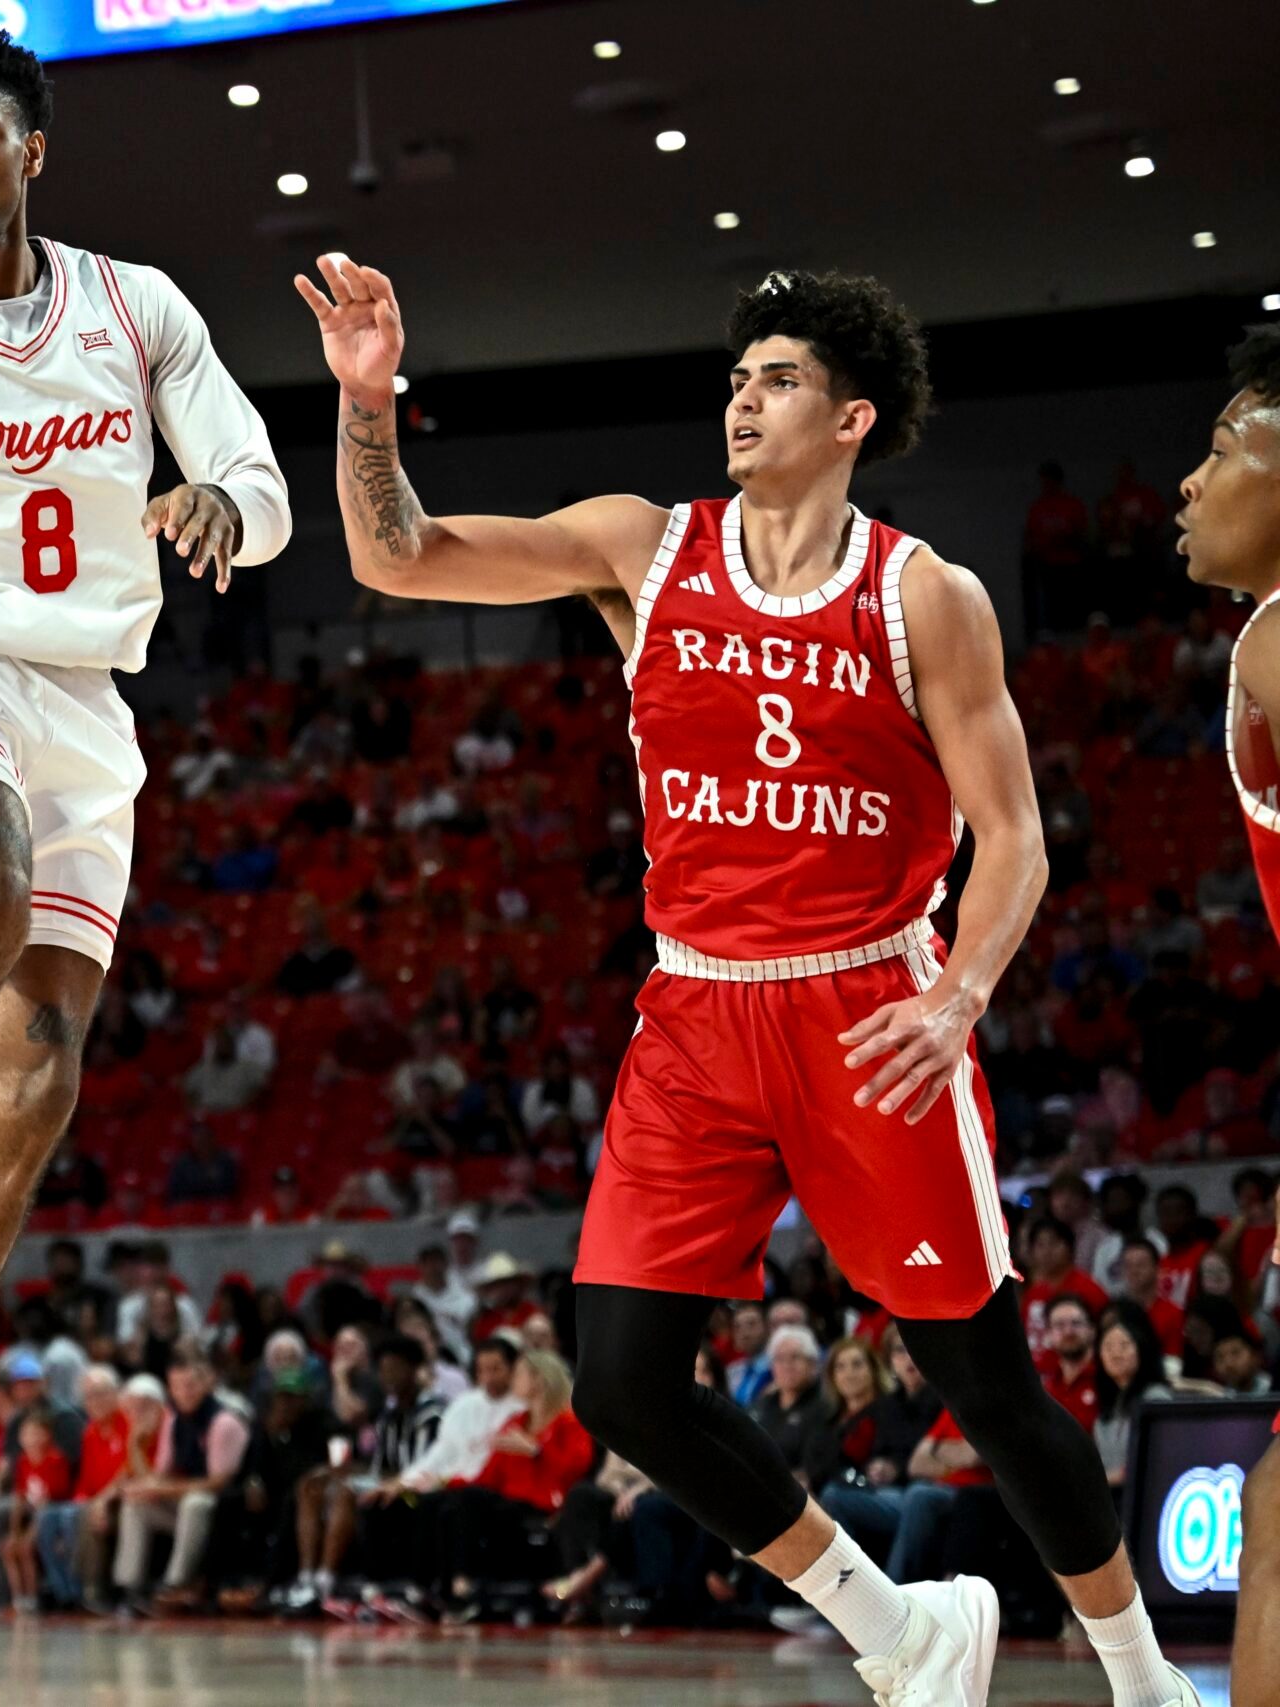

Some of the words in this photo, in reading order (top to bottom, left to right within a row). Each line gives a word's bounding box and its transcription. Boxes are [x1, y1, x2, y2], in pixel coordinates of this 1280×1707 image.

[21, 488, 77, 593] 8
[672, 628, 871, 697] RAGIN
[755, 693, 802, 769] 8
[661, 768, 891, 837] CAJUNS
